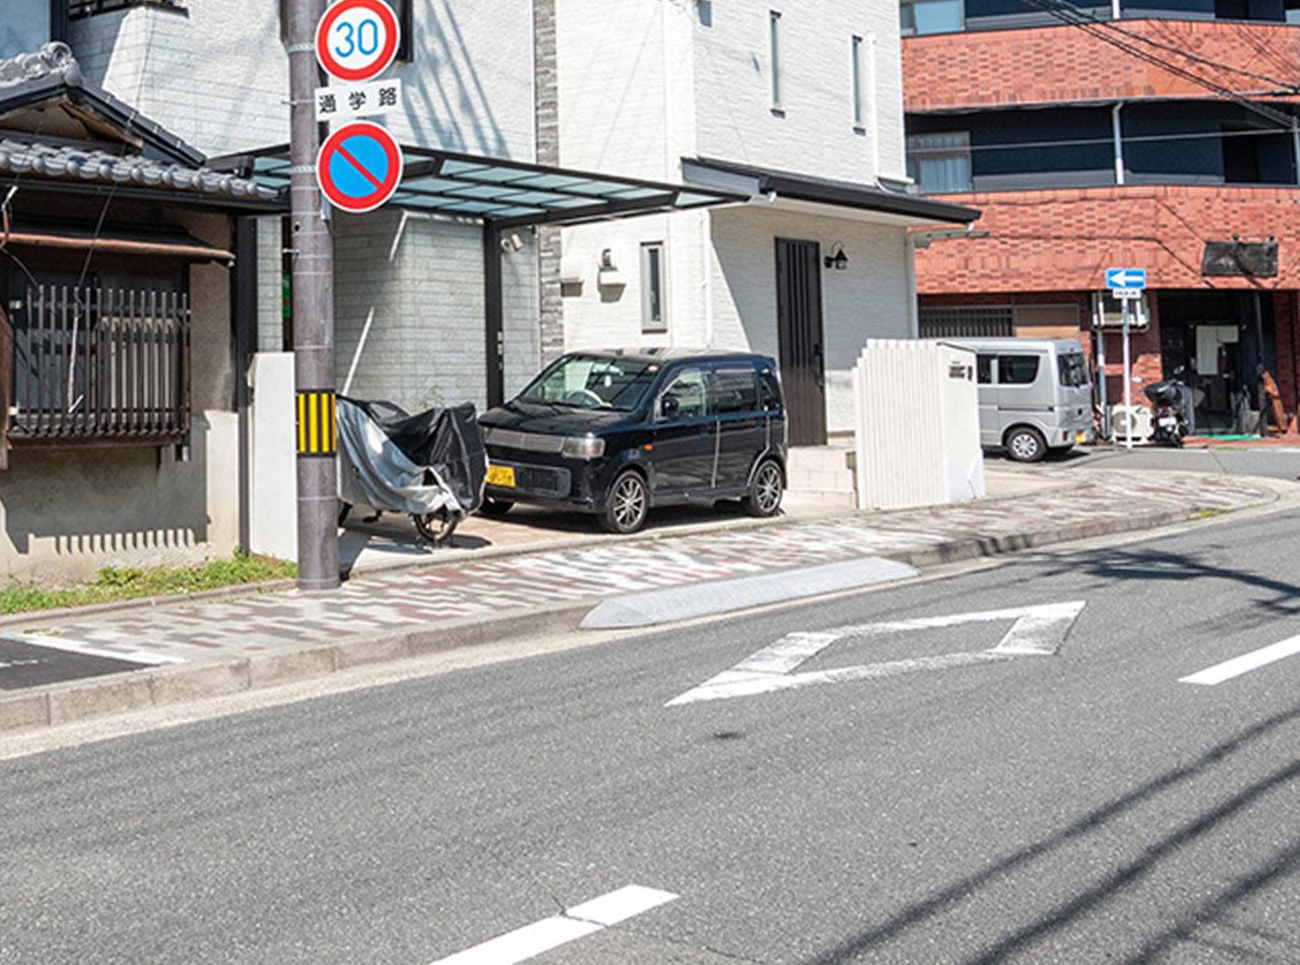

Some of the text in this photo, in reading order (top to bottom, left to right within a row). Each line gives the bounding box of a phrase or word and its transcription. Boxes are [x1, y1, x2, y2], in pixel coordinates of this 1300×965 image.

[335, 18, 378, 58] 30
[318, 87, 397, 114] 通学路
